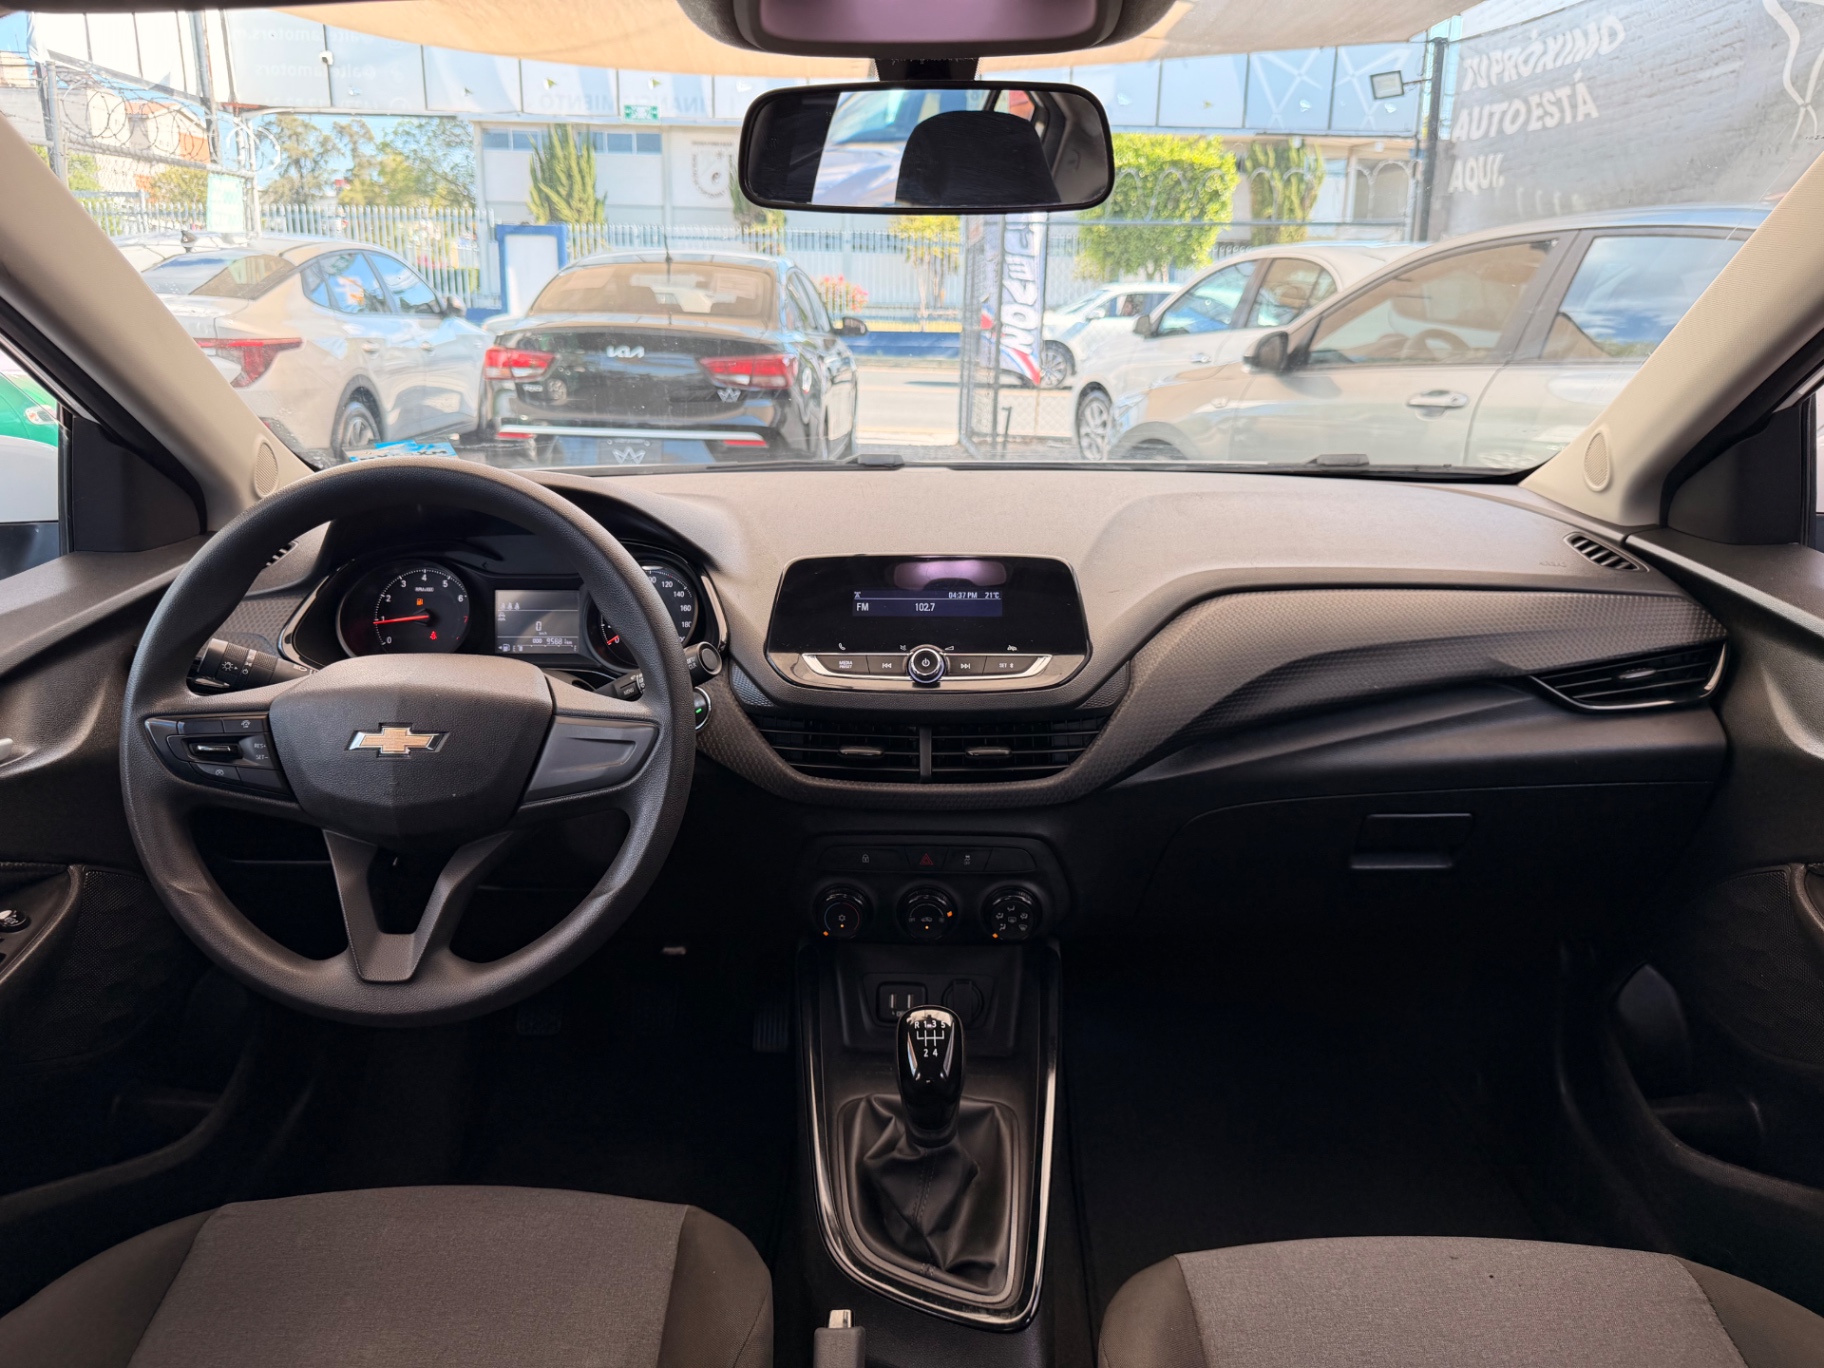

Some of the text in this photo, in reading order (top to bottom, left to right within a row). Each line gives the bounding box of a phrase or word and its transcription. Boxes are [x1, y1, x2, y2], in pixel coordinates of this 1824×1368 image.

[1489, 15, 1626, 86] PRÓXIMO
[1451, 67, 1599, 143] AUTO ESTÁ
[606, 345, 645, 358] KIA
[401, 580, 407, 588] 3
[442, 580, 448, 588] 5
[458, 594, 464, 602] 6
[856, 603, 936, 612] FM 102.7
[535, 621, 542, 631] 0
[386, 636, 392, 644] 0
[914, 1021, 920, 1029] R
[931, 1020, 937, 1028] 3
[923, 1048, 938, 1058] 2 4
